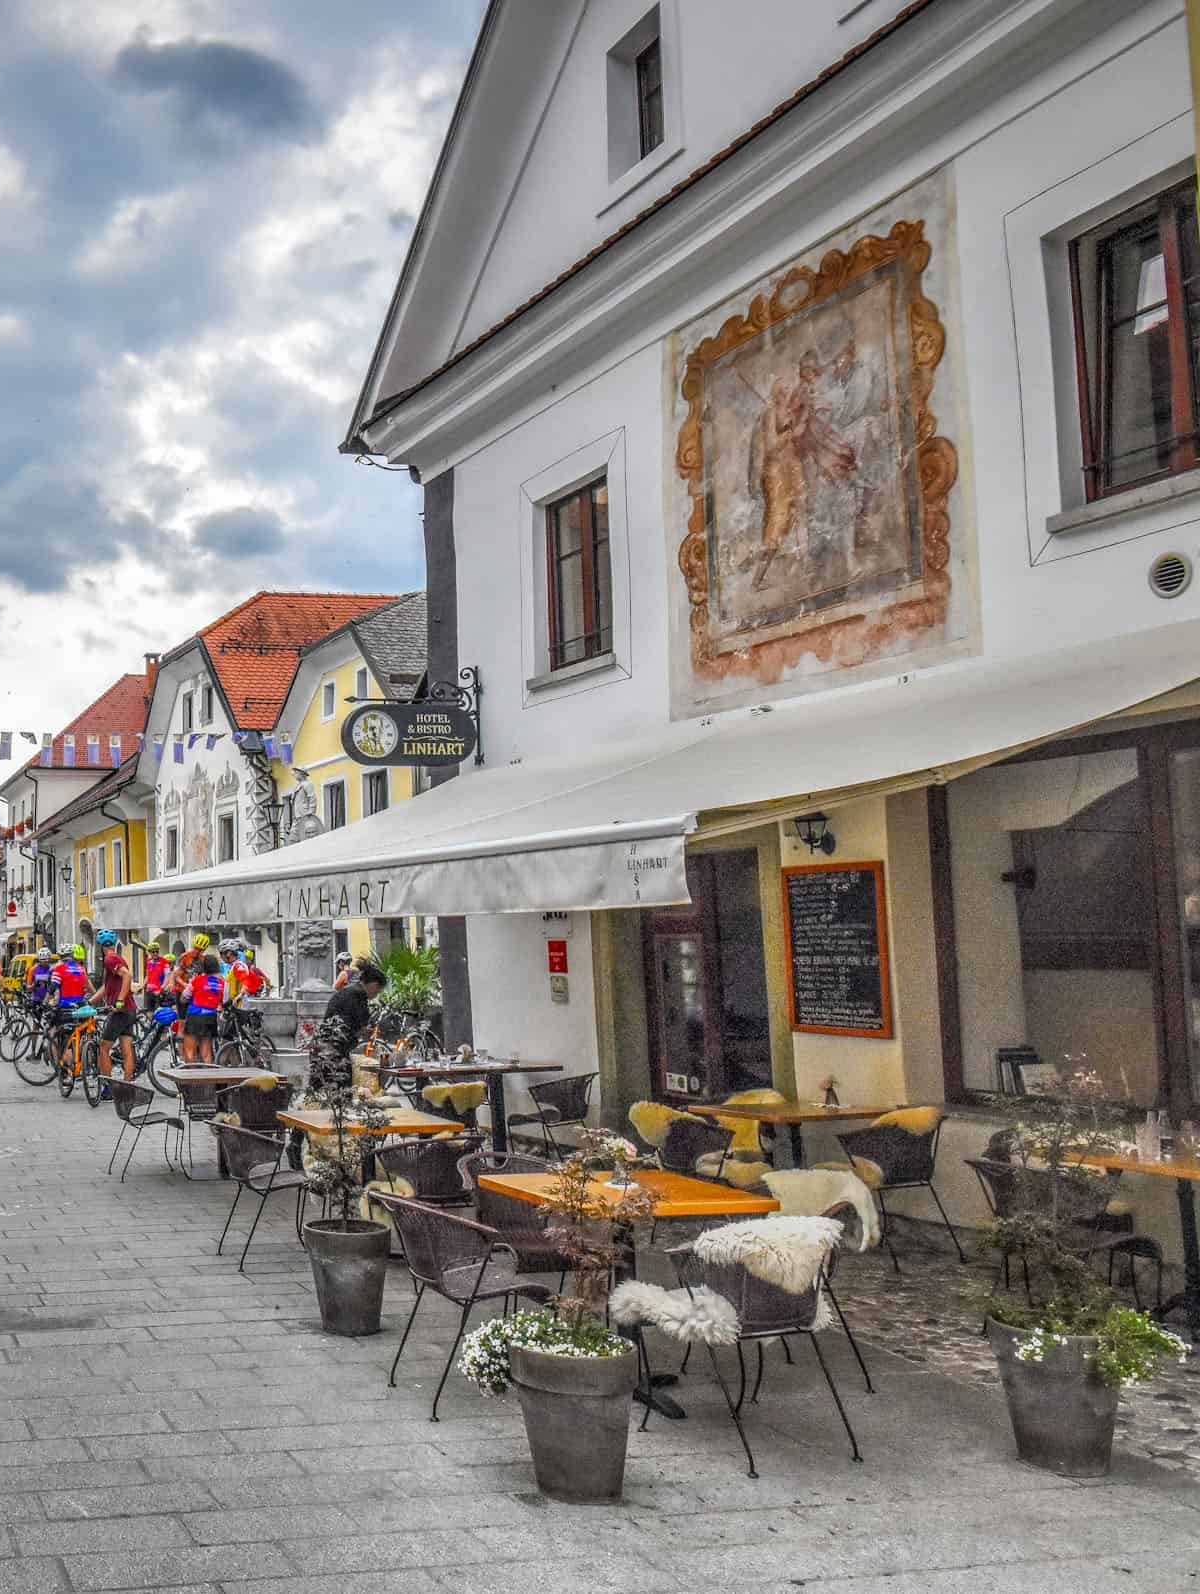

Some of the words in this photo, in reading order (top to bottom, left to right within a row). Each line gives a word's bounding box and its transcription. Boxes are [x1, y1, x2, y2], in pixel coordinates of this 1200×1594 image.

[416, 713, 451, 724] HOTEL
[416, 724, 452, 734] BISTRO
[403, 742, 465, 756] LINHART
[627, 856, 668, 871] LINHART
[185, 891, 228, 922] HIŠA
[276, 880, 390, 918] LINHART
